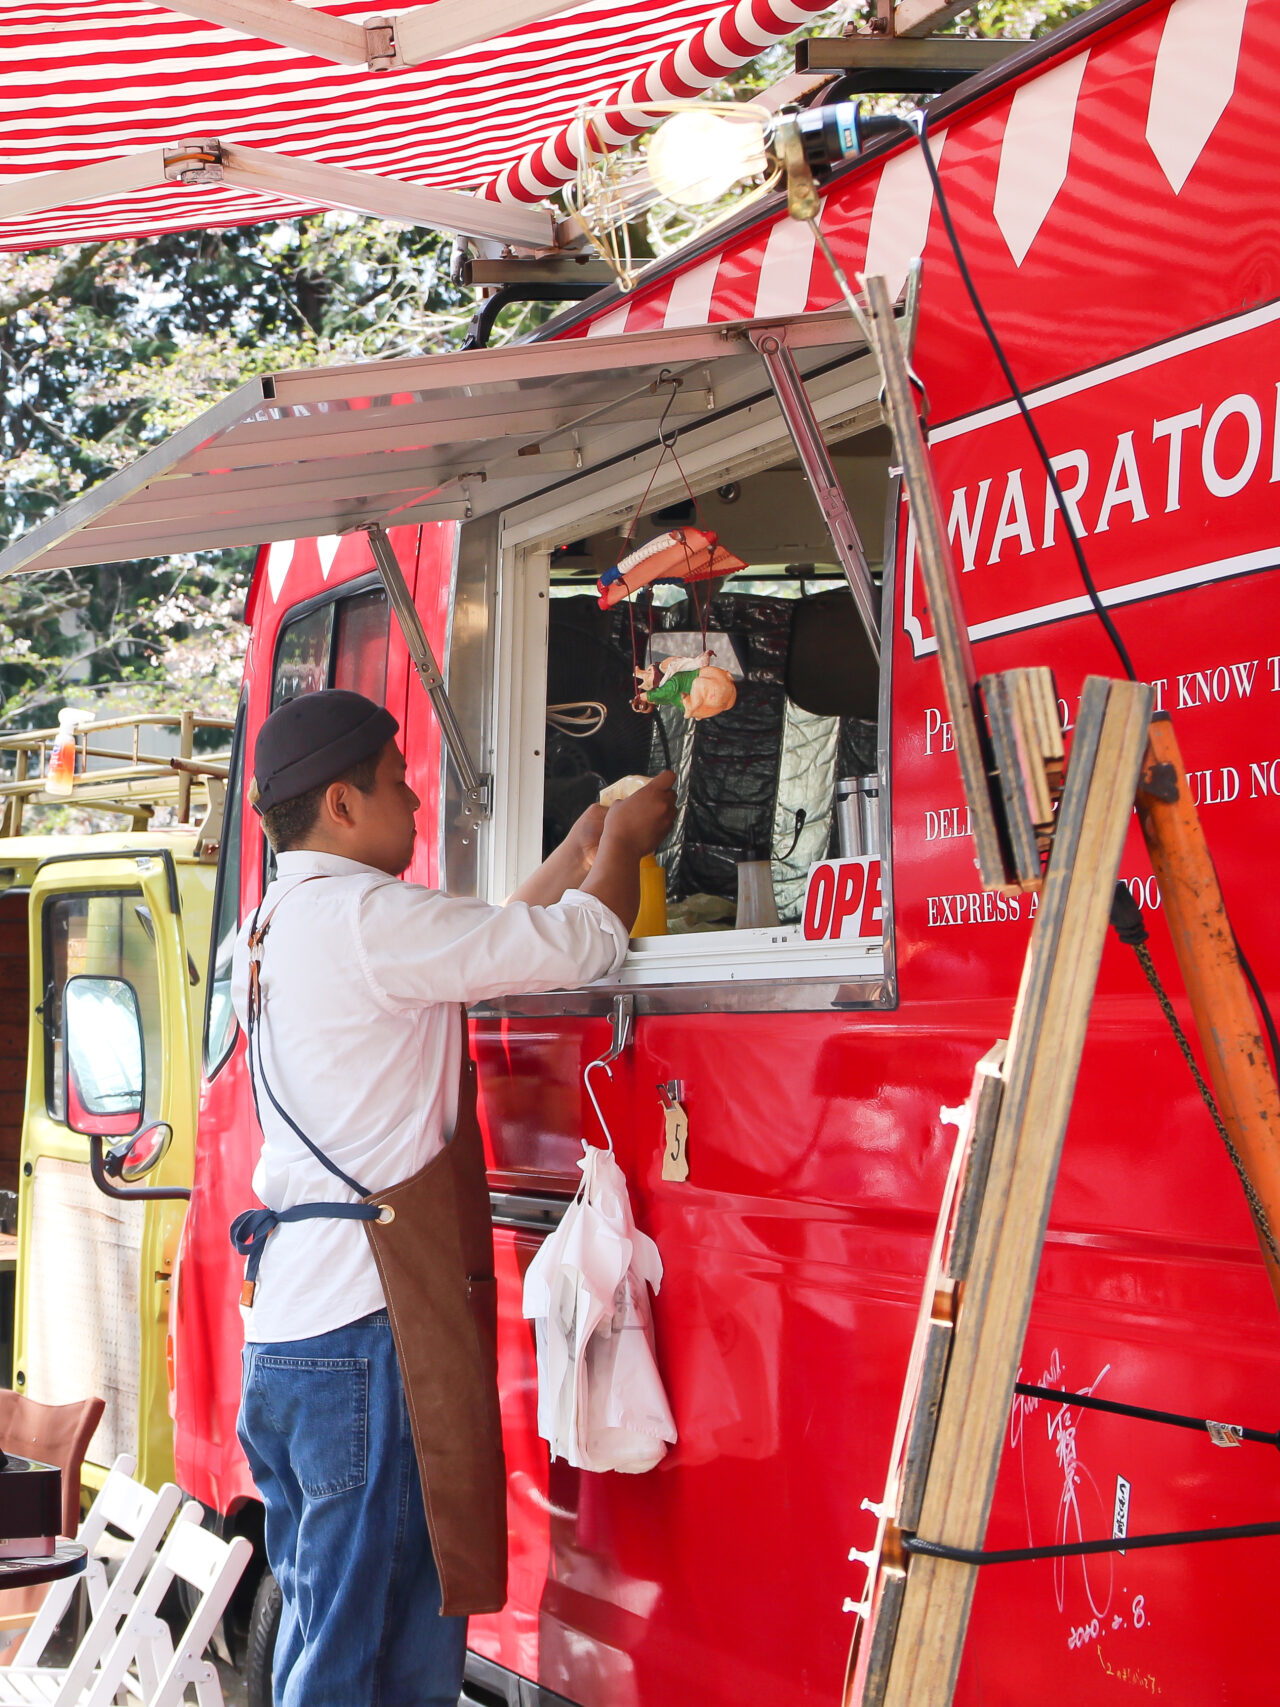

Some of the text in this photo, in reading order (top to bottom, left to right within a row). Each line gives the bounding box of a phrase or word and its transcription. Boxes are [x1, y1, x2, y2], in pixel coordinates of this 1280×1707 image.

[947, 382, 1280, 573] WARATO
[1176, 660, 1259, 709] KNOW
[804, 860, 883, 941] OPE
[926, 889, 1021, 927] EXPRESS
[670, 1123, 681, 1162] 5
